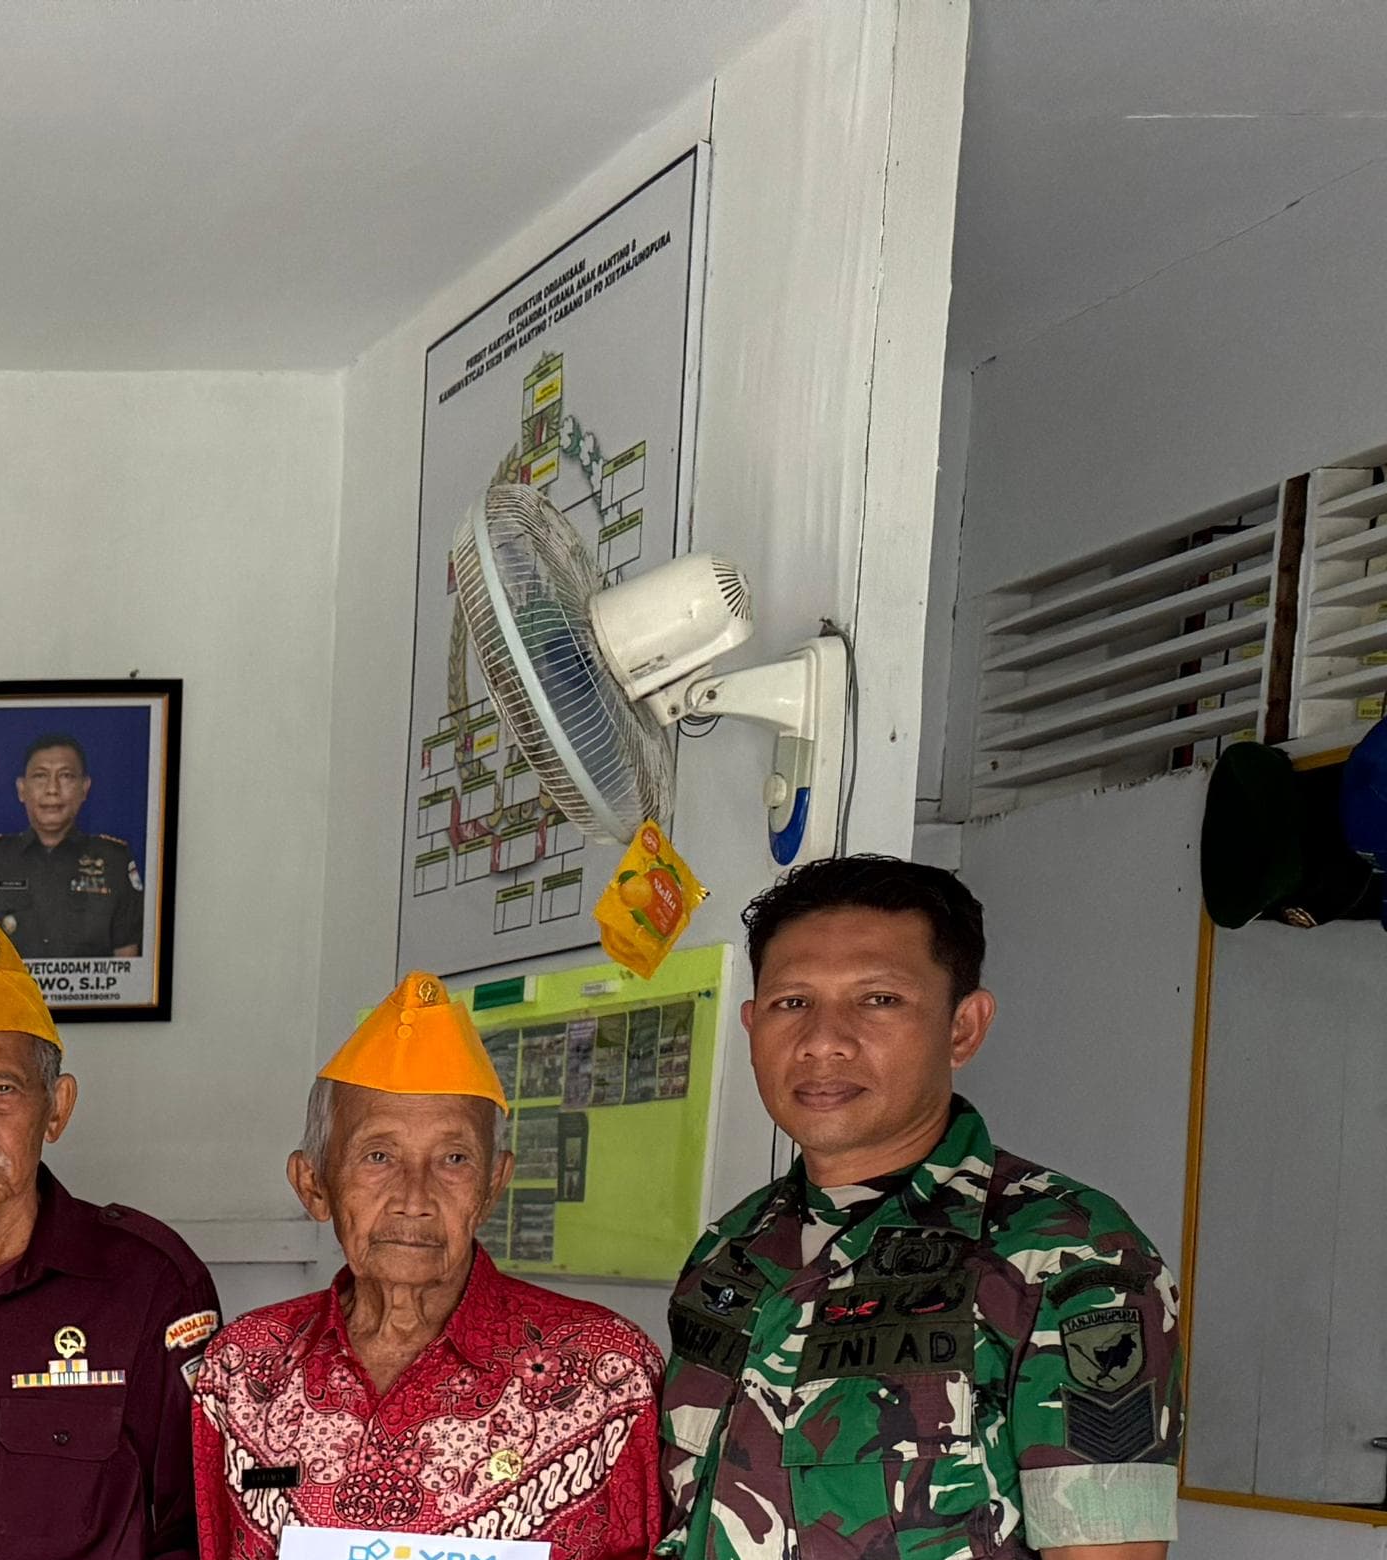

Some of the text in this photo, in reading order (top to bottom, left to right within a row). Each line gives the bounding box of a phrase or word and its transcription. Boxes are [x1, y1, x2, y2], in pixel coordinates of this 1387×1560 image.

[544, 258, 586, 300] ORGANISASI
[79, 977, 118, 991] S.I.P
[1064, 1309, 1138, 1332] TANJUNGPURA
[816, 1330, 959, 1370] TNI AD
